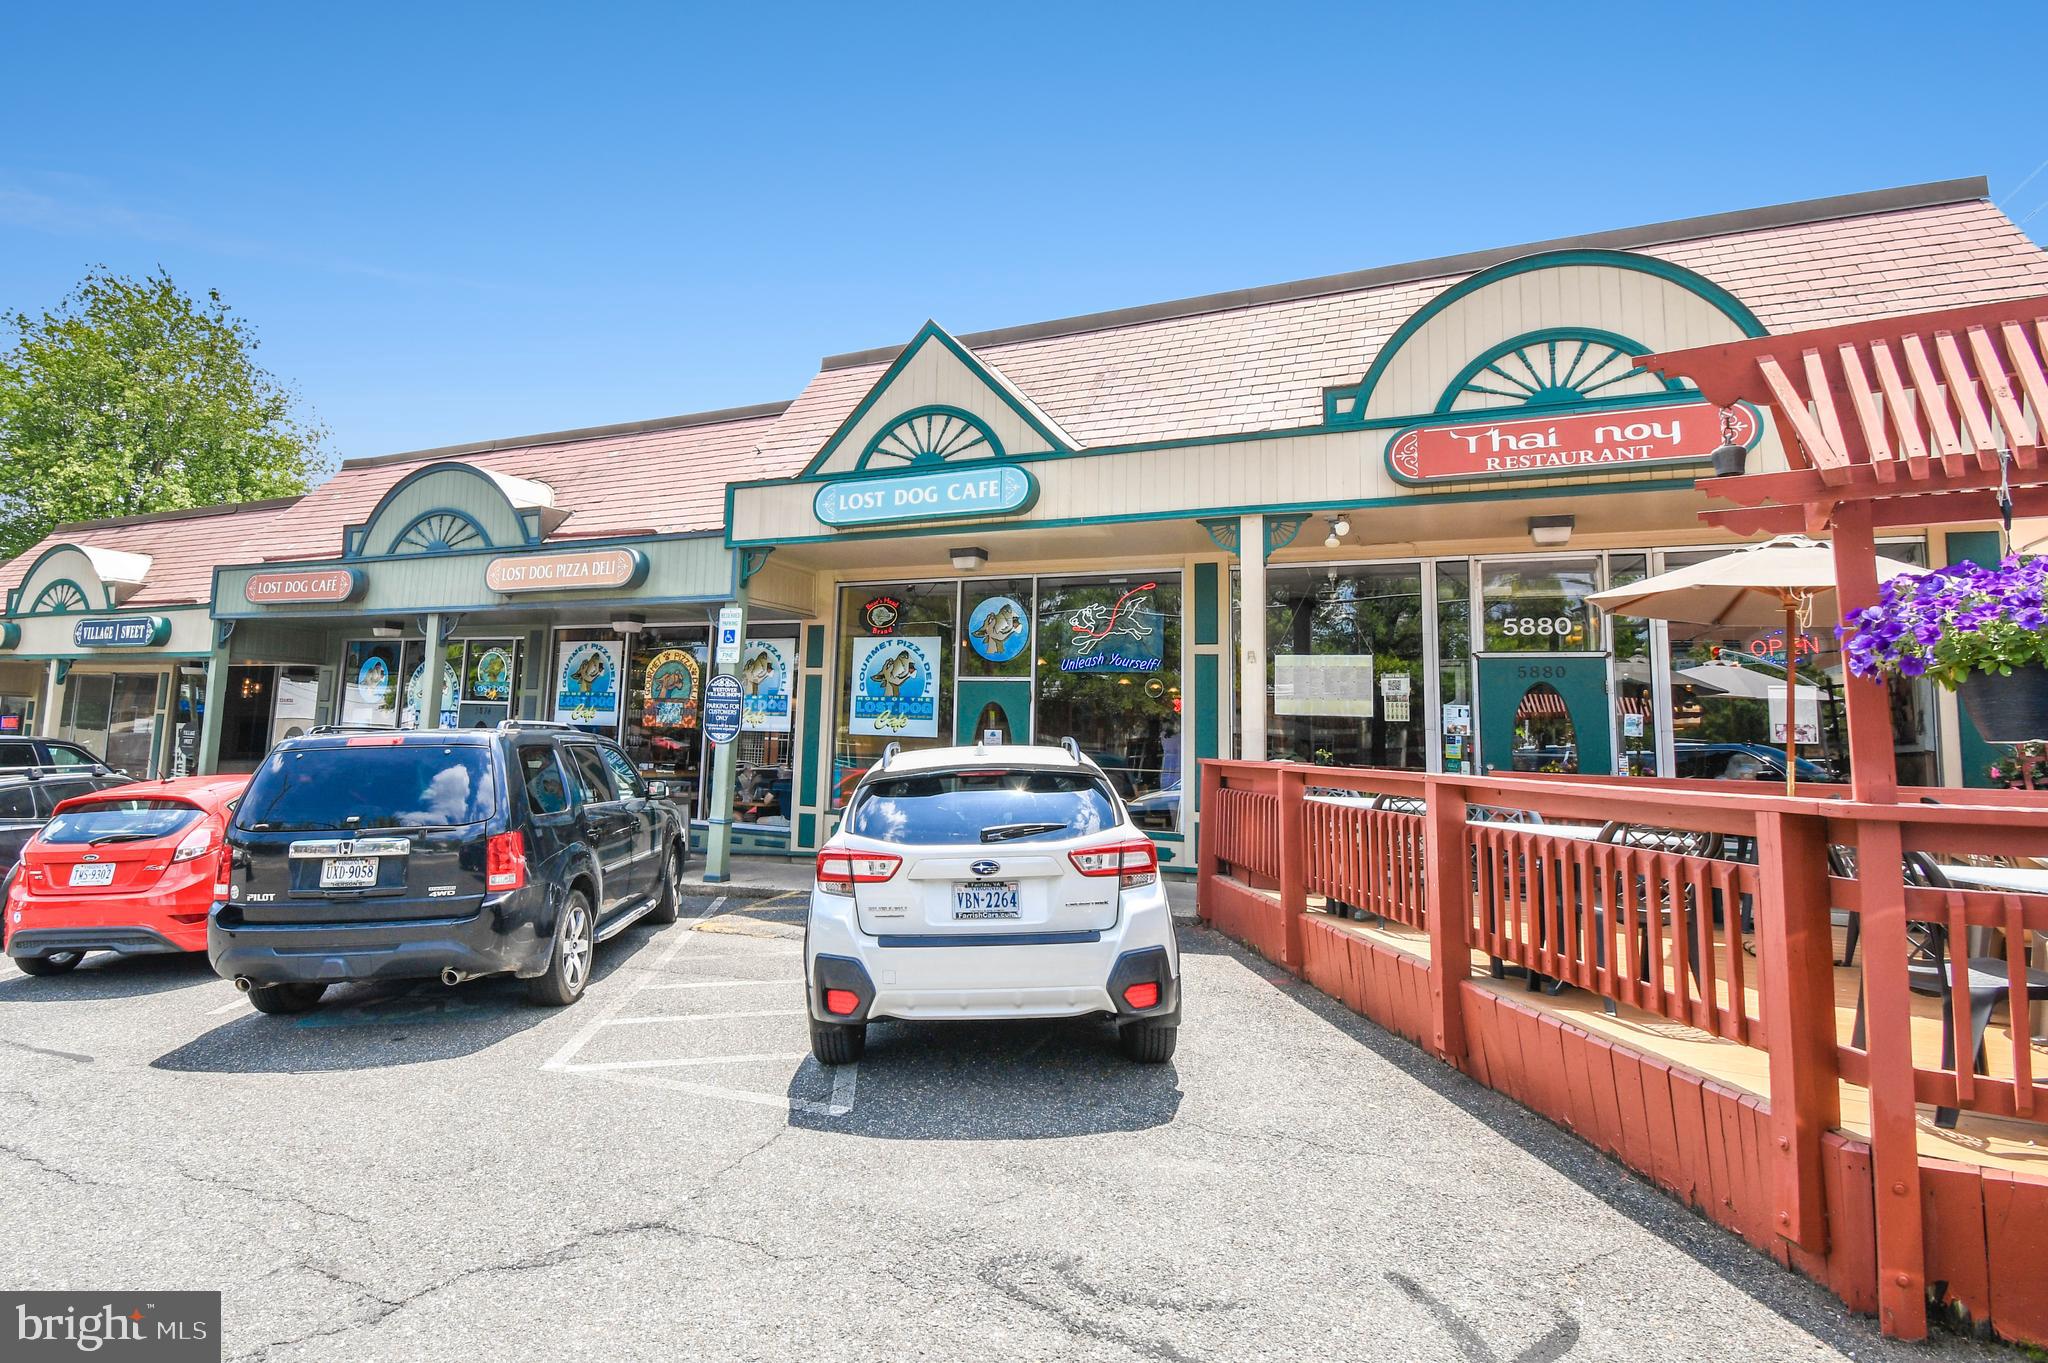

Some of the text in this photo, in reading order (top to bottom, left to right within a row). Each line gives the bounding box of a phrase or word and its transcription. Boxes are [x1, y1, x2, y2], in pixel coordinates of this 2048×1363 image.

[1449, 420, 1681, 453] Thai noy
[1485, 445, 1654, 471] RESTAURANT
[839, 480, 999, 511] LOST DOG CAFE
[501, 561, 615, 581] LOST DOG PIZZA DELI
[258, 576, 337, 594] LOST DOG CAFÉ
[83, 626, 114, 640] VILLAGE
[121, 625, 145, 639] SWEET
[1503, 617, 1572, 636] 5880
[757, 641, 781, 661] PIZZA
[562, 643, 589, 688] GOURMET
[591, 643, 611, 662] PIZZA
[859, 639, 932, 693] GOURMET PIZZA DELI
[1061, 652, 1161, 671] Unleash Yourself!
[645, 657, 662, 696] GOURMET
[674, 652, 693, 671] PIZZA
[1517, 665, 1566, 678] 5880
[856, 701, 932, 714] LOST DOG
[246, 893, 276, 901] PILOT
[957, 891, 1017, 909] VBN-2264
